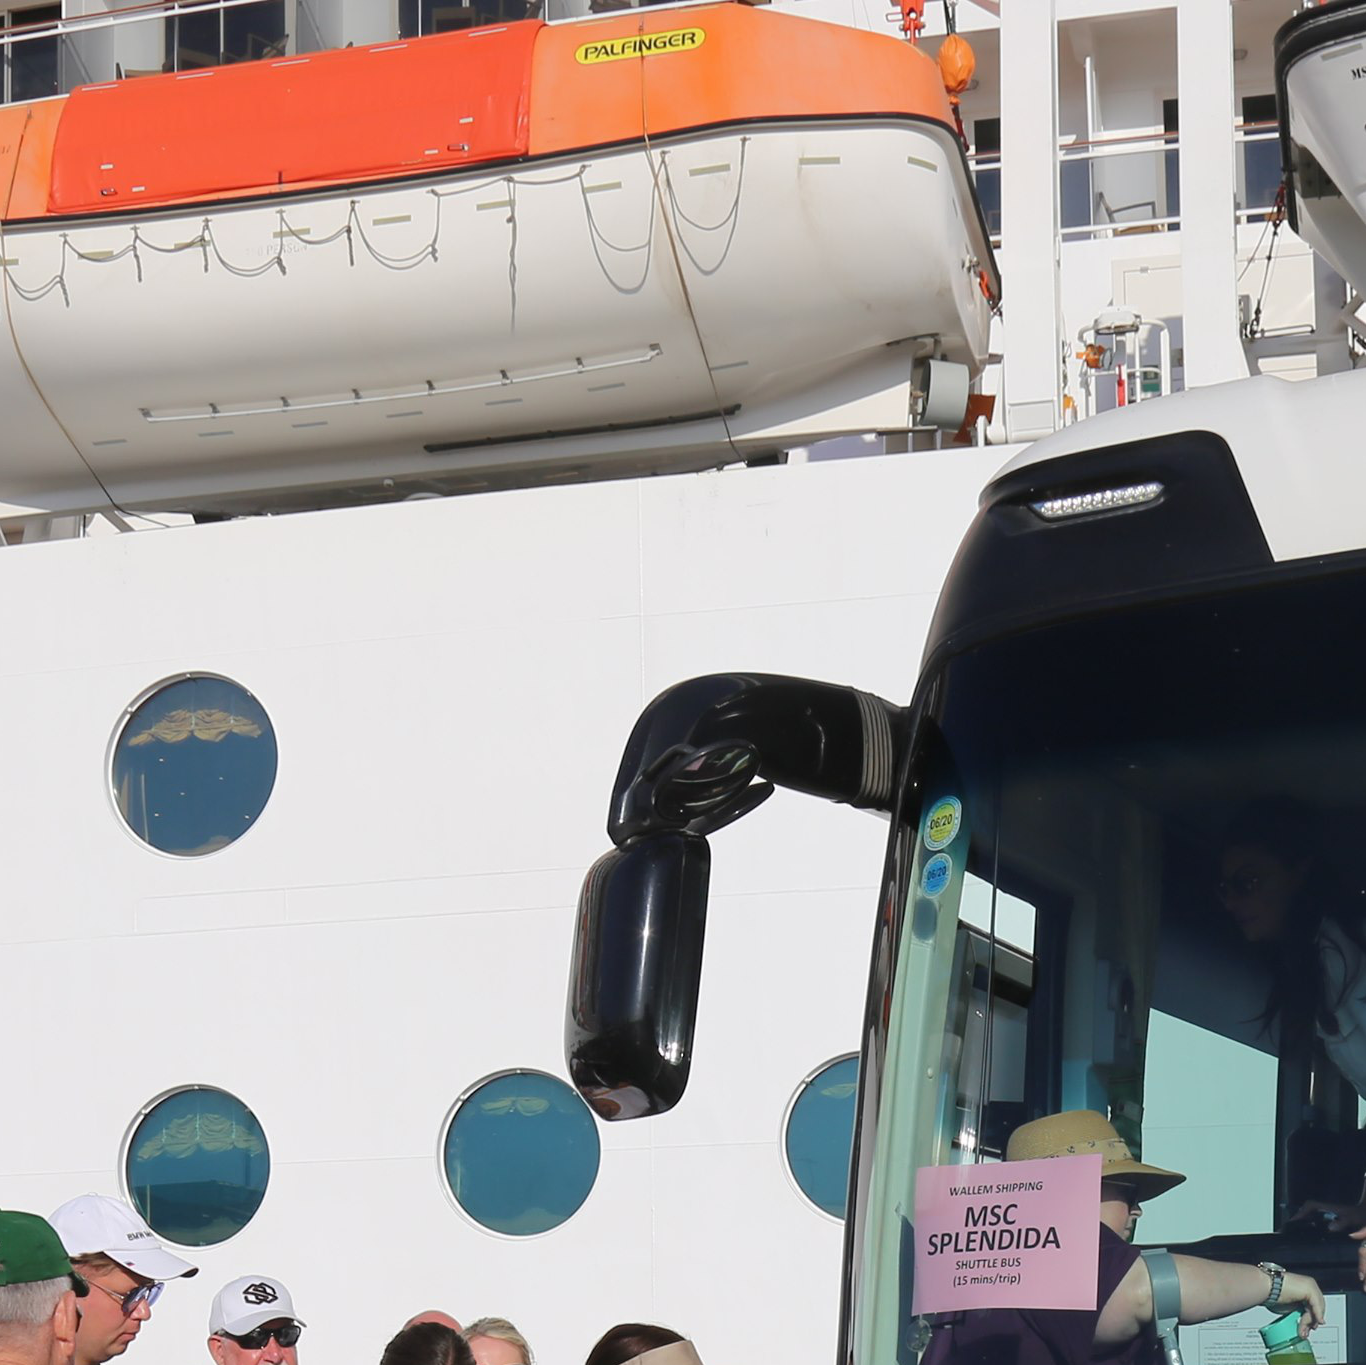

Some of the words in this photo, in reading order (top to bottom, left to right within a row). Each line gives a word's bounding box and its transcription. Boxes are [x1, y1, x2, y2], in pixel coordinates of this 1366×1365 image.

[584, 32, 697, 60] PALFINGER
[949, 1185, 994, 1197] WALLEM
[995, 1181, 1044, 1195] SHIPPING
[964, 1203, 1019, 1228] MSC
[927, 1226, 1062, 1256] SPLENDIDA
[955, 1258, 999, 1270] SHUTTLE
[1000, 1257, 1022, 1269] BUS
[953, 1275, 968, 1288] (15
[970, 1273, 1022, 1286] mins/trip)
